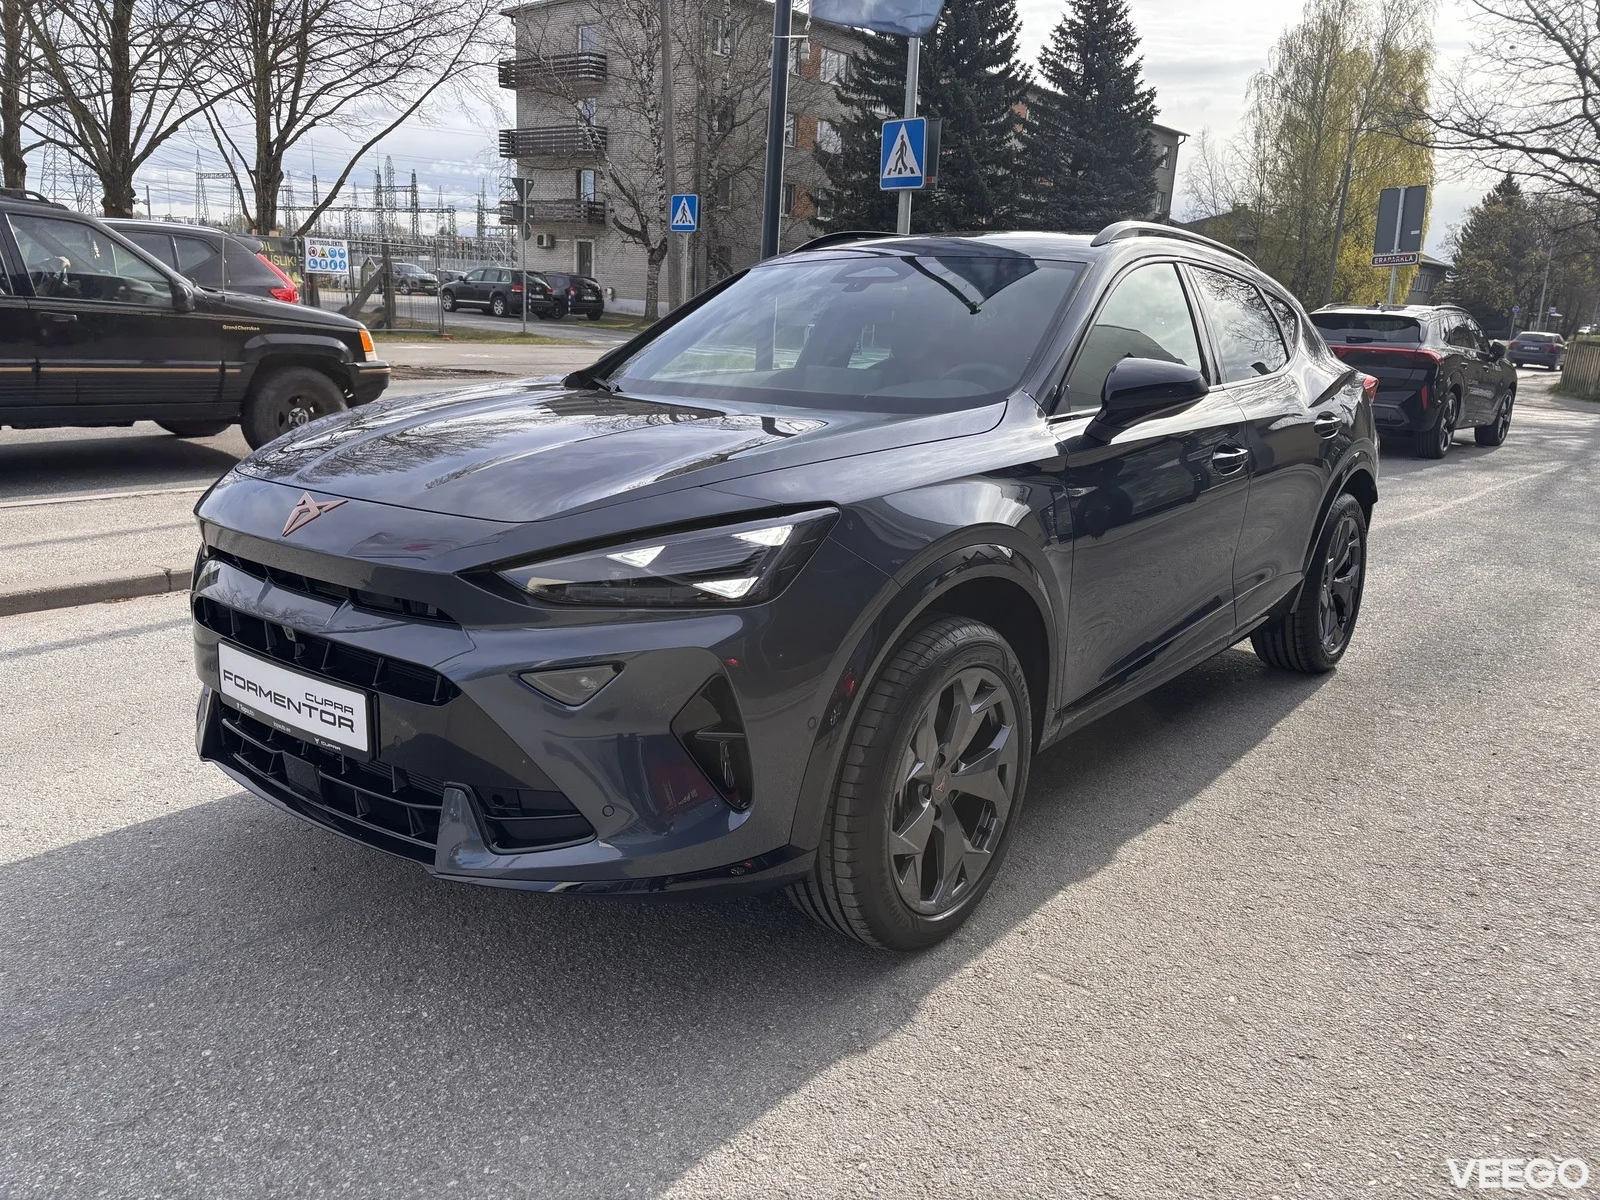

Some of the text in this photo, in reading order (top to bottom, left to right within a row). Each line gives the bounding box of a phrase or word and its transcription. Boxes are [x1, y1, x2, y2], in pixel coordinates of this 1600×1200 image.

[223, 669, 355, 733] FORMENTOR
[305, 692, 354, 716] CUPRA
[320, 740, 342, 751] CUPRA
